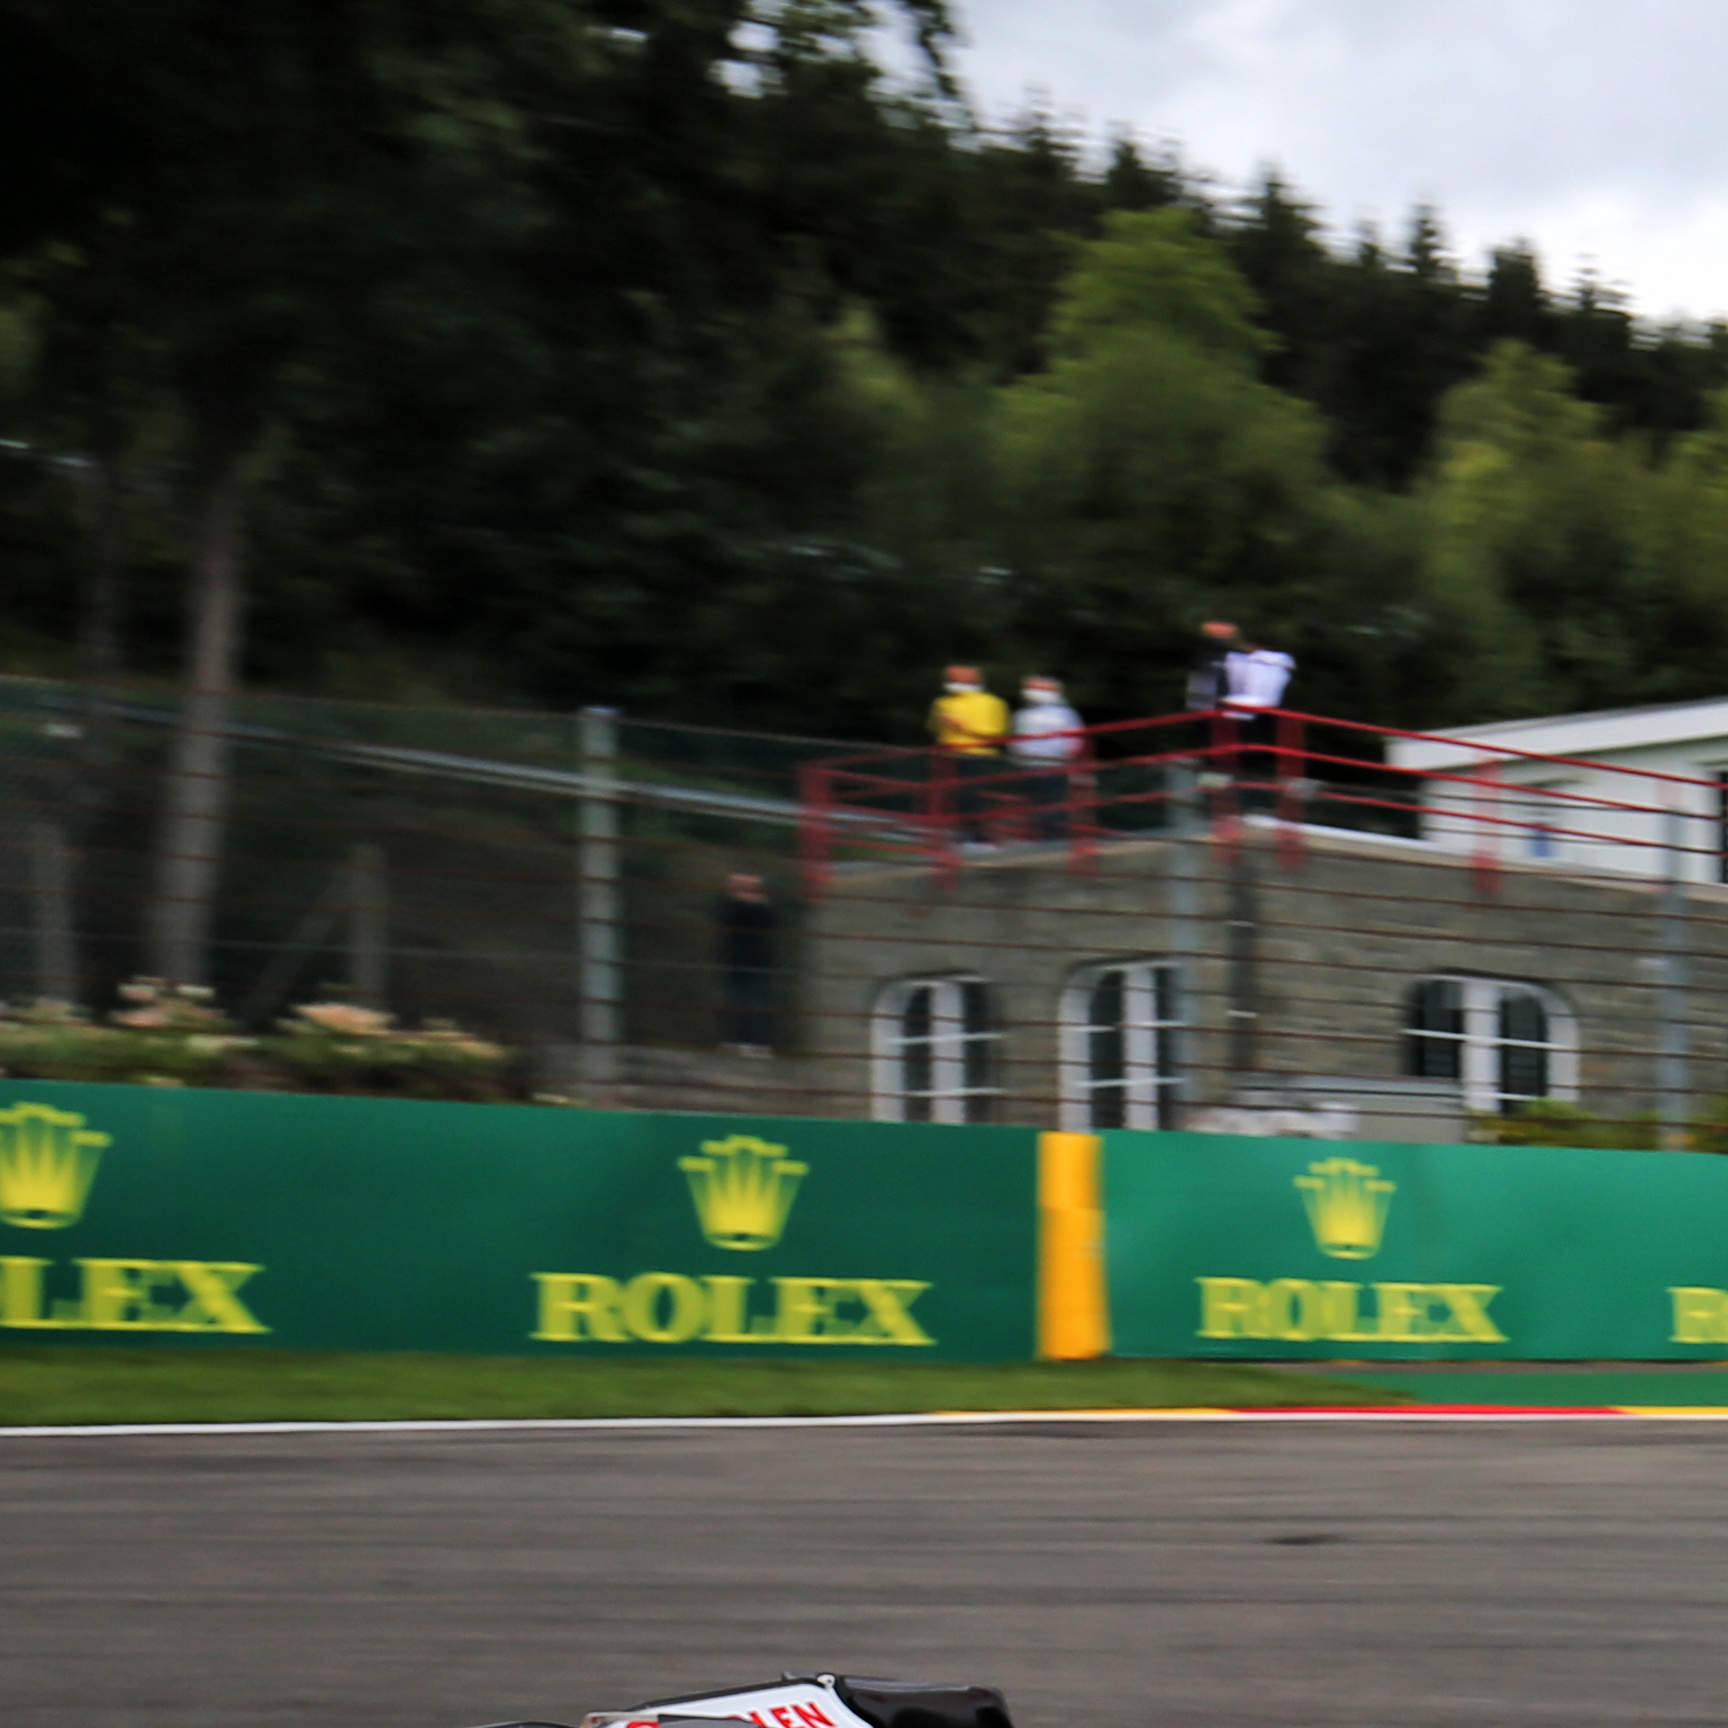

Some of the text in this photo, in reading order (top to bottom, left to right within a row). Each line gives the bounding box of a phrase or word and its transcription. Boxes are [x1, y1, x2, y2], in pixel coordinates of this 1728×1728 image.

[0, 1256, 272, 1335] LEX
[528, 1271, 936, 1346] ROLEX
[1196, 1276, 1509, 1343] ROLEX
